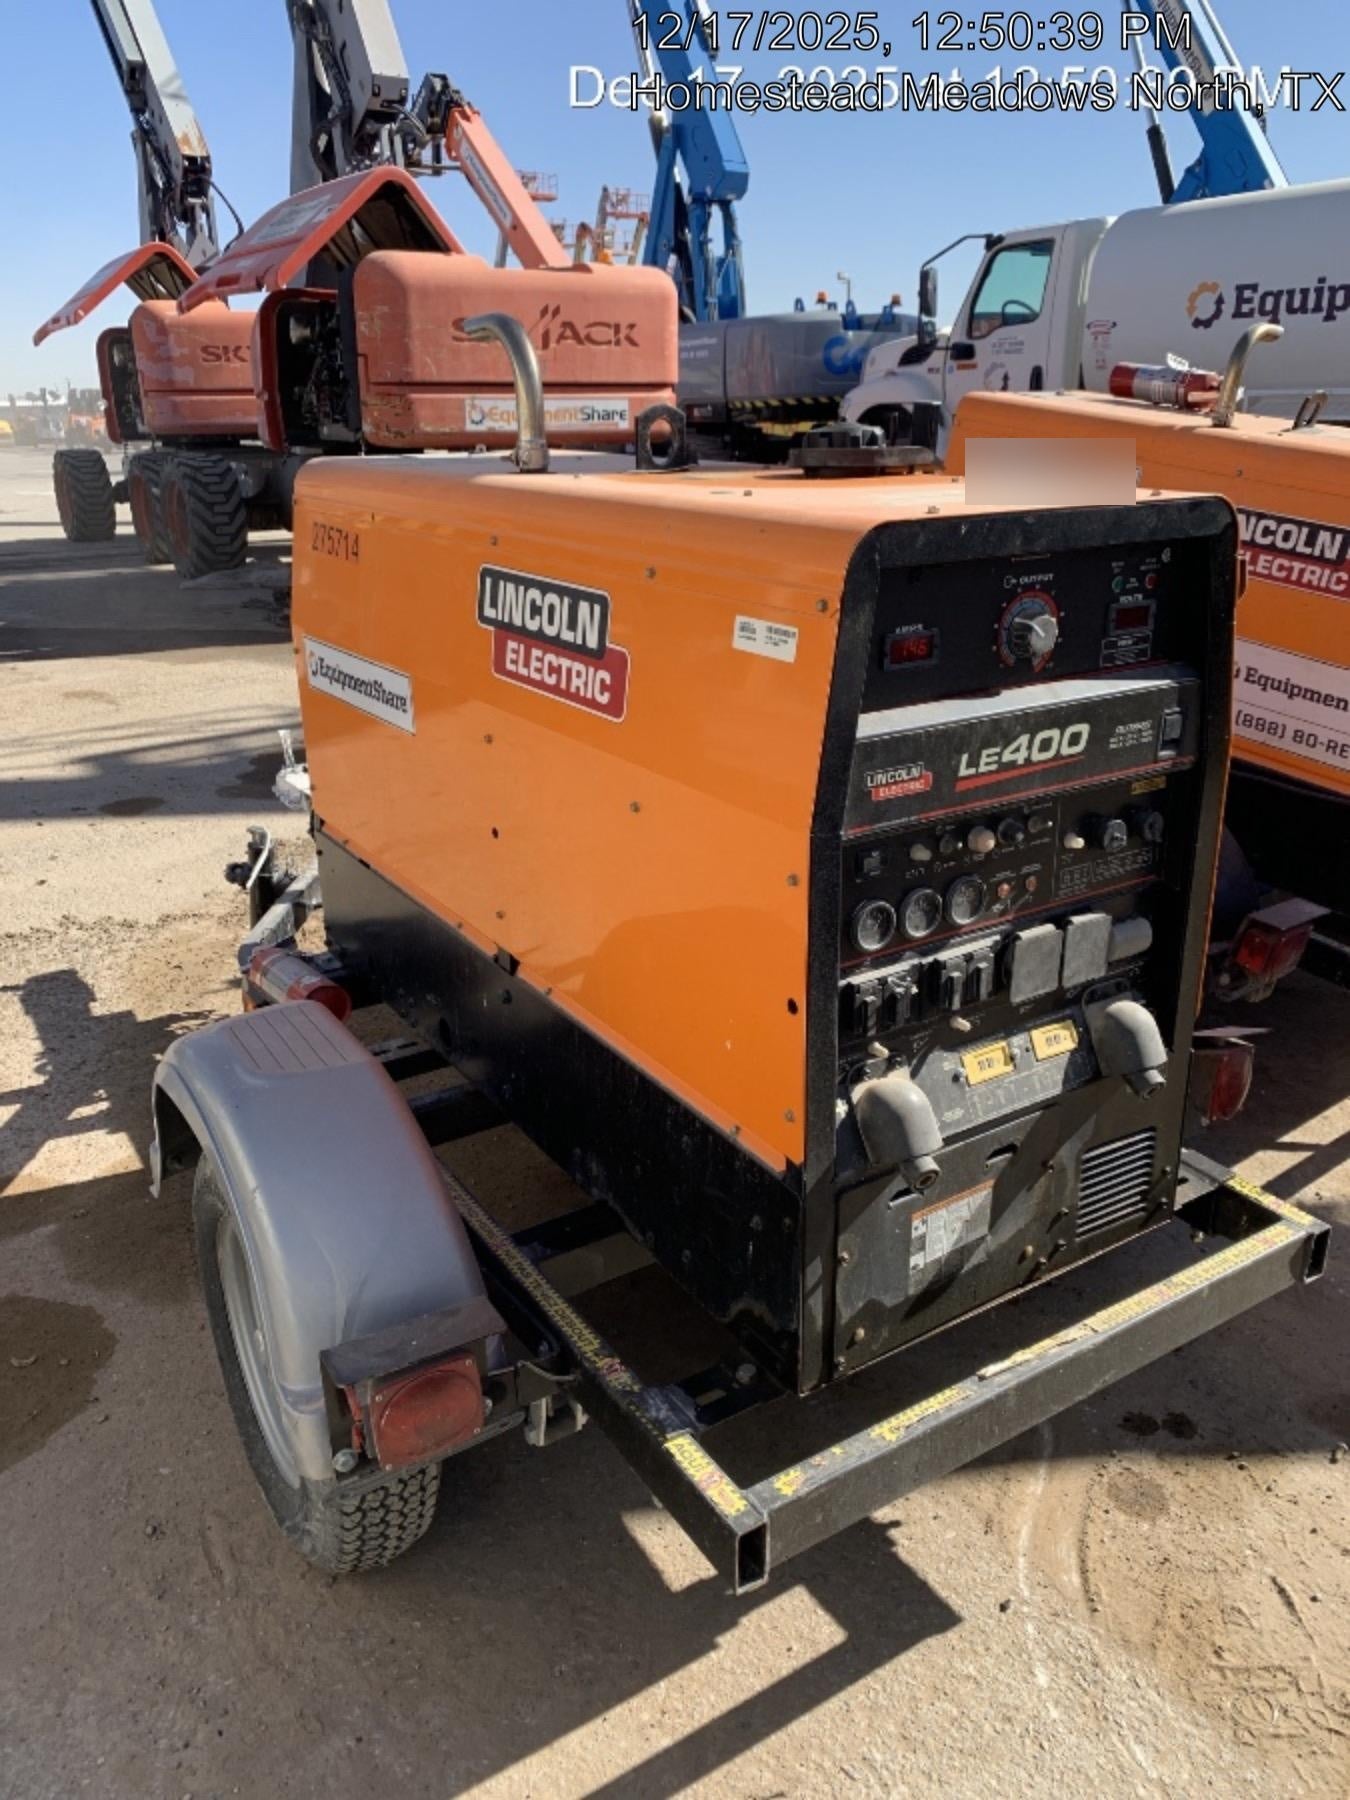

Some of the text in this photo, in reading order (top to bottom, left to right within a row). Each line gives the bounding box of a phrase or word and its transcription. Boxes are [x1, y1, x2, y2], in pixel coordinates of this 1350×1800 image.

[483, 576, 601, 650] LINCOLN
[505, 639, 612, 705] ELECTRIC
[957, 722, 1092, 778] LE400
[1235, 709, 1287, 740] (888)
[867, 763, 923, 788] LINCOLN
